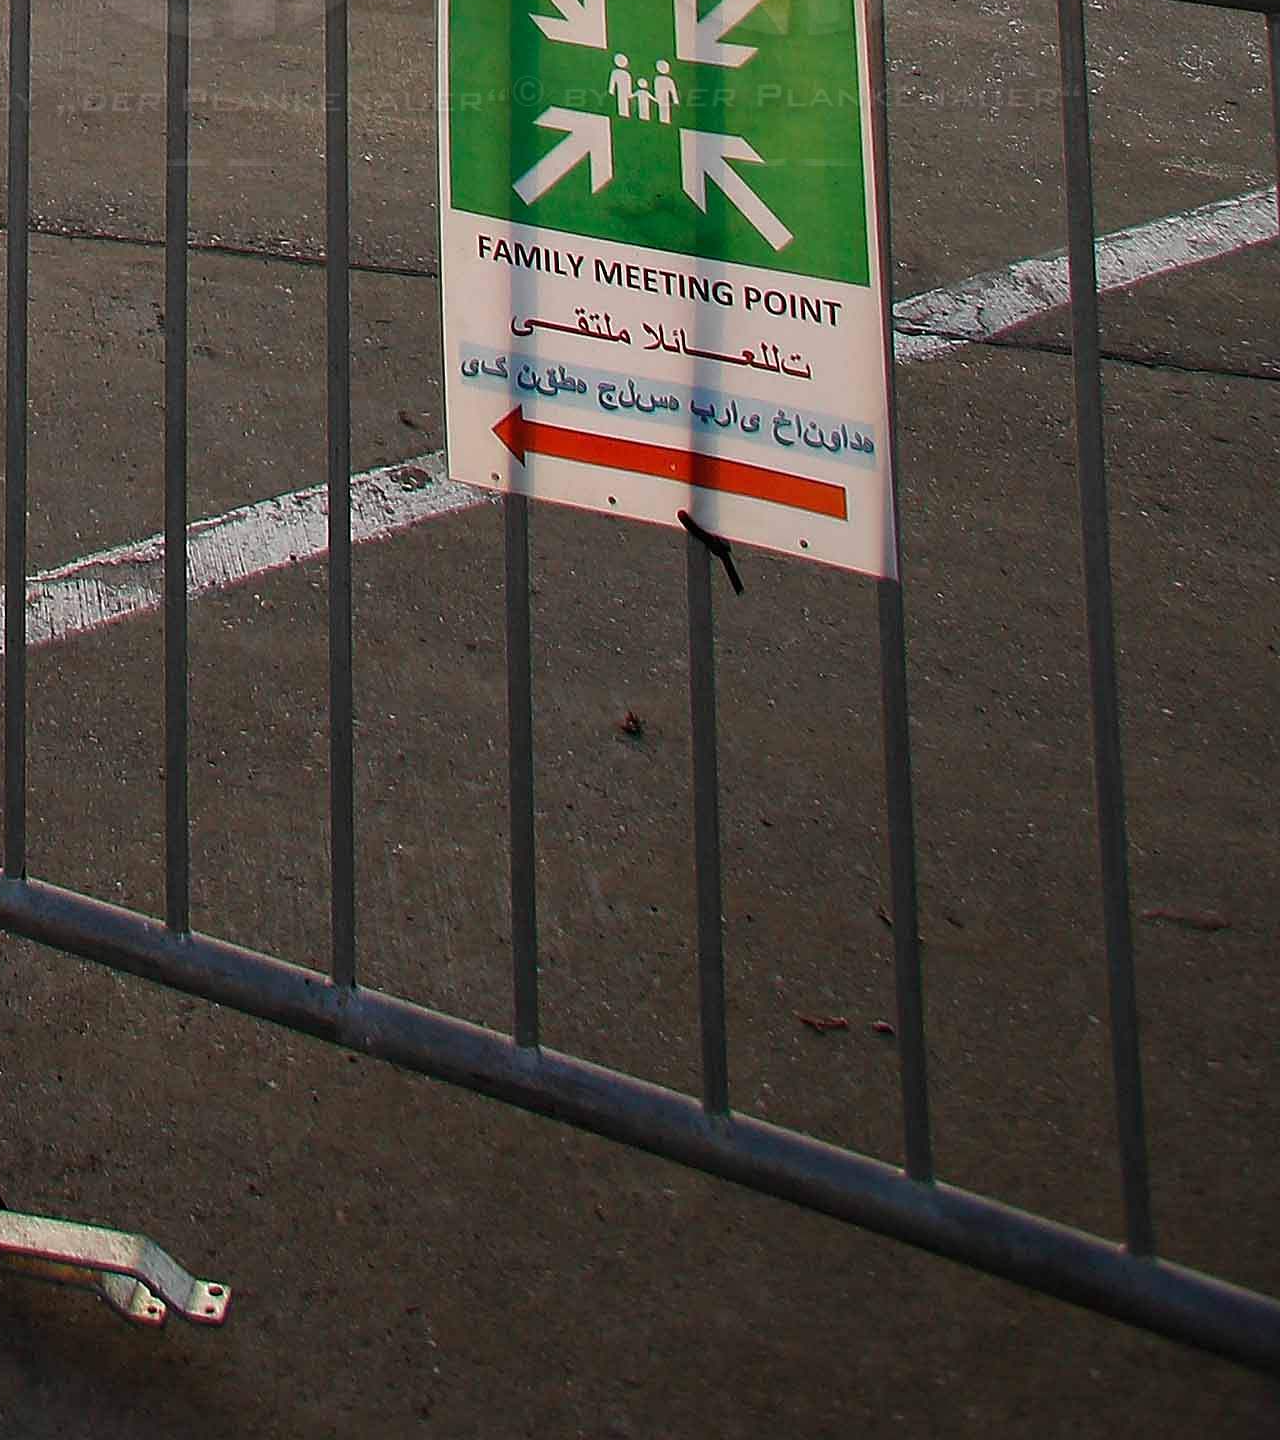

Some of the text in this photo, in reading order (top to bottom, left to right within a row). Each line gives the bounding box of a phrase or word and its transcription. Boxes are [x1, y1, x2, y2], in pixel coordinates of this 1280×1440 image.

[478, 235, 842, 328] FAMILY MEETING POINT
